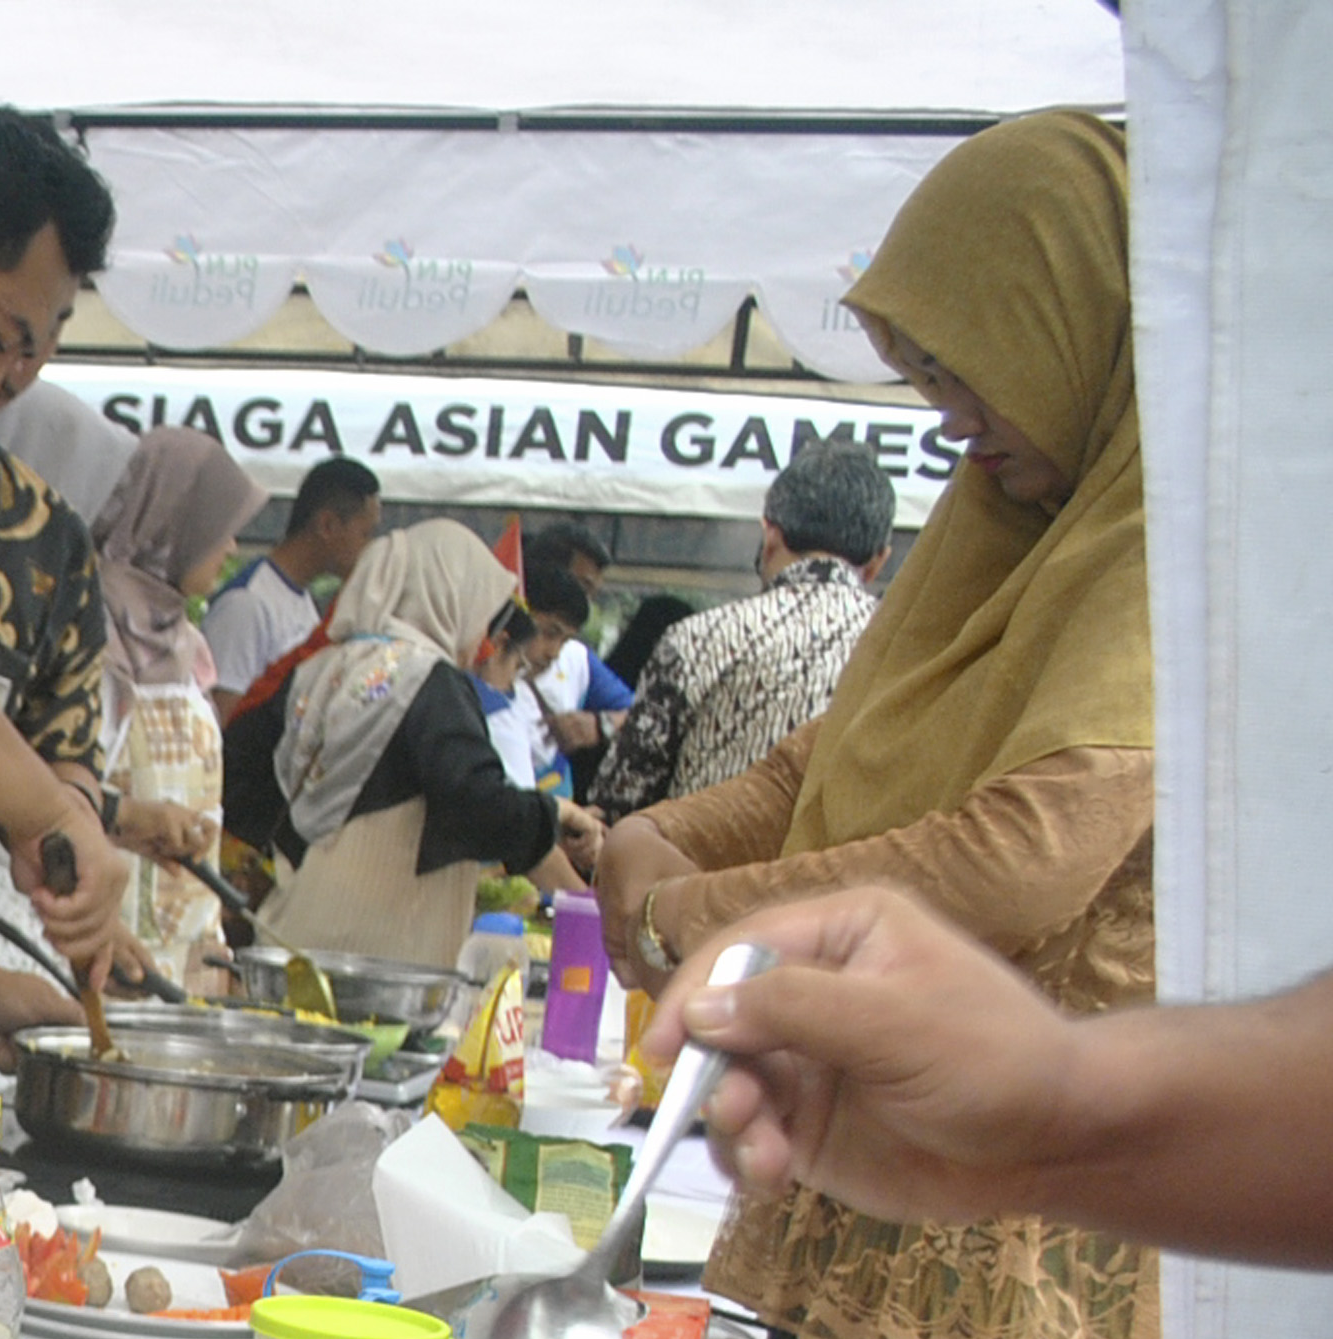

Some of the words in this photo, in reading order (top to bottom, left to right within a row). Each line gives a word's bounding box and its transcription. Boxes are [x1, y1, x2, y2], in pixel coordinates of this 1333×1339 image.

[101, 394, 344, 455] SIAGA
[370, 401, 632, 462] ASIAN
[660, 411, 969, 481] GAMES
